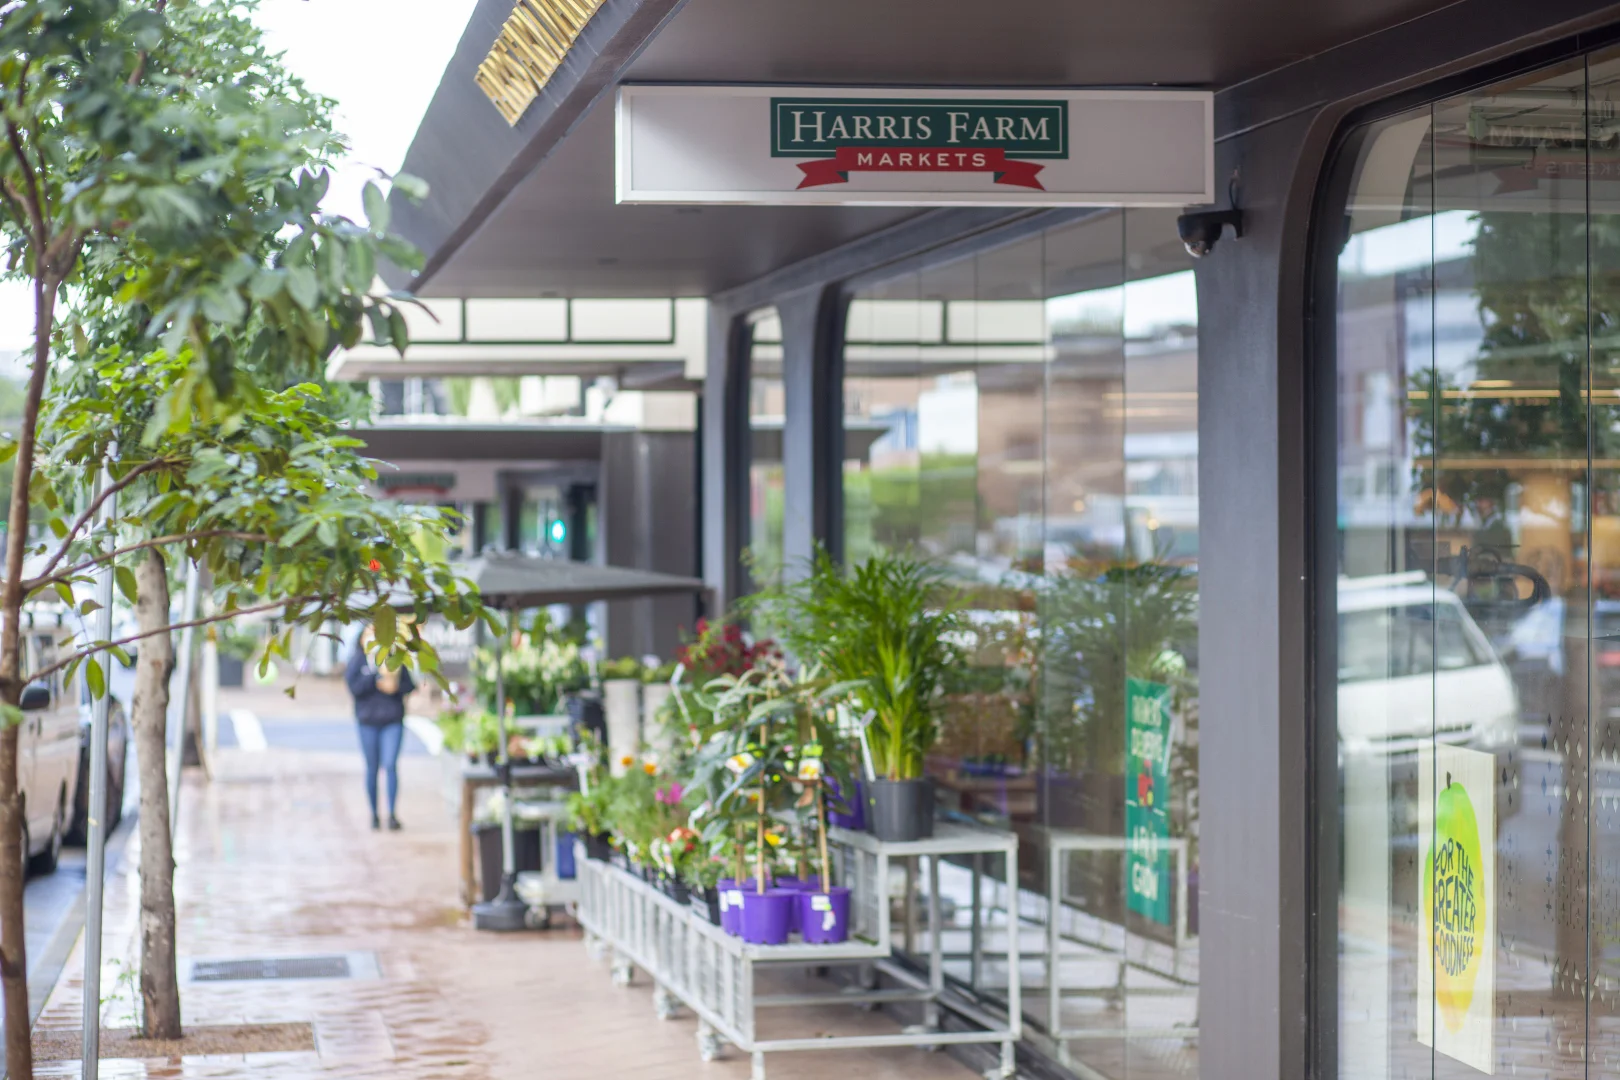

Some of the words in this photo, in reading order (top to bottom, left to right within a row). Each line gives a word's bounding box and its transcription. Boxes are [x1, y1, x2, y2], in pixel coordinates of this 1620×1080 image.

[790, 111, 933, 142] HARRIS
[946, 111, 1051, 143] FARM
[857, 152, 987, 167] MARKETS
[1456, 840, 1474, 898] THE
[1435, 925, 1474, 976] OODNESS
